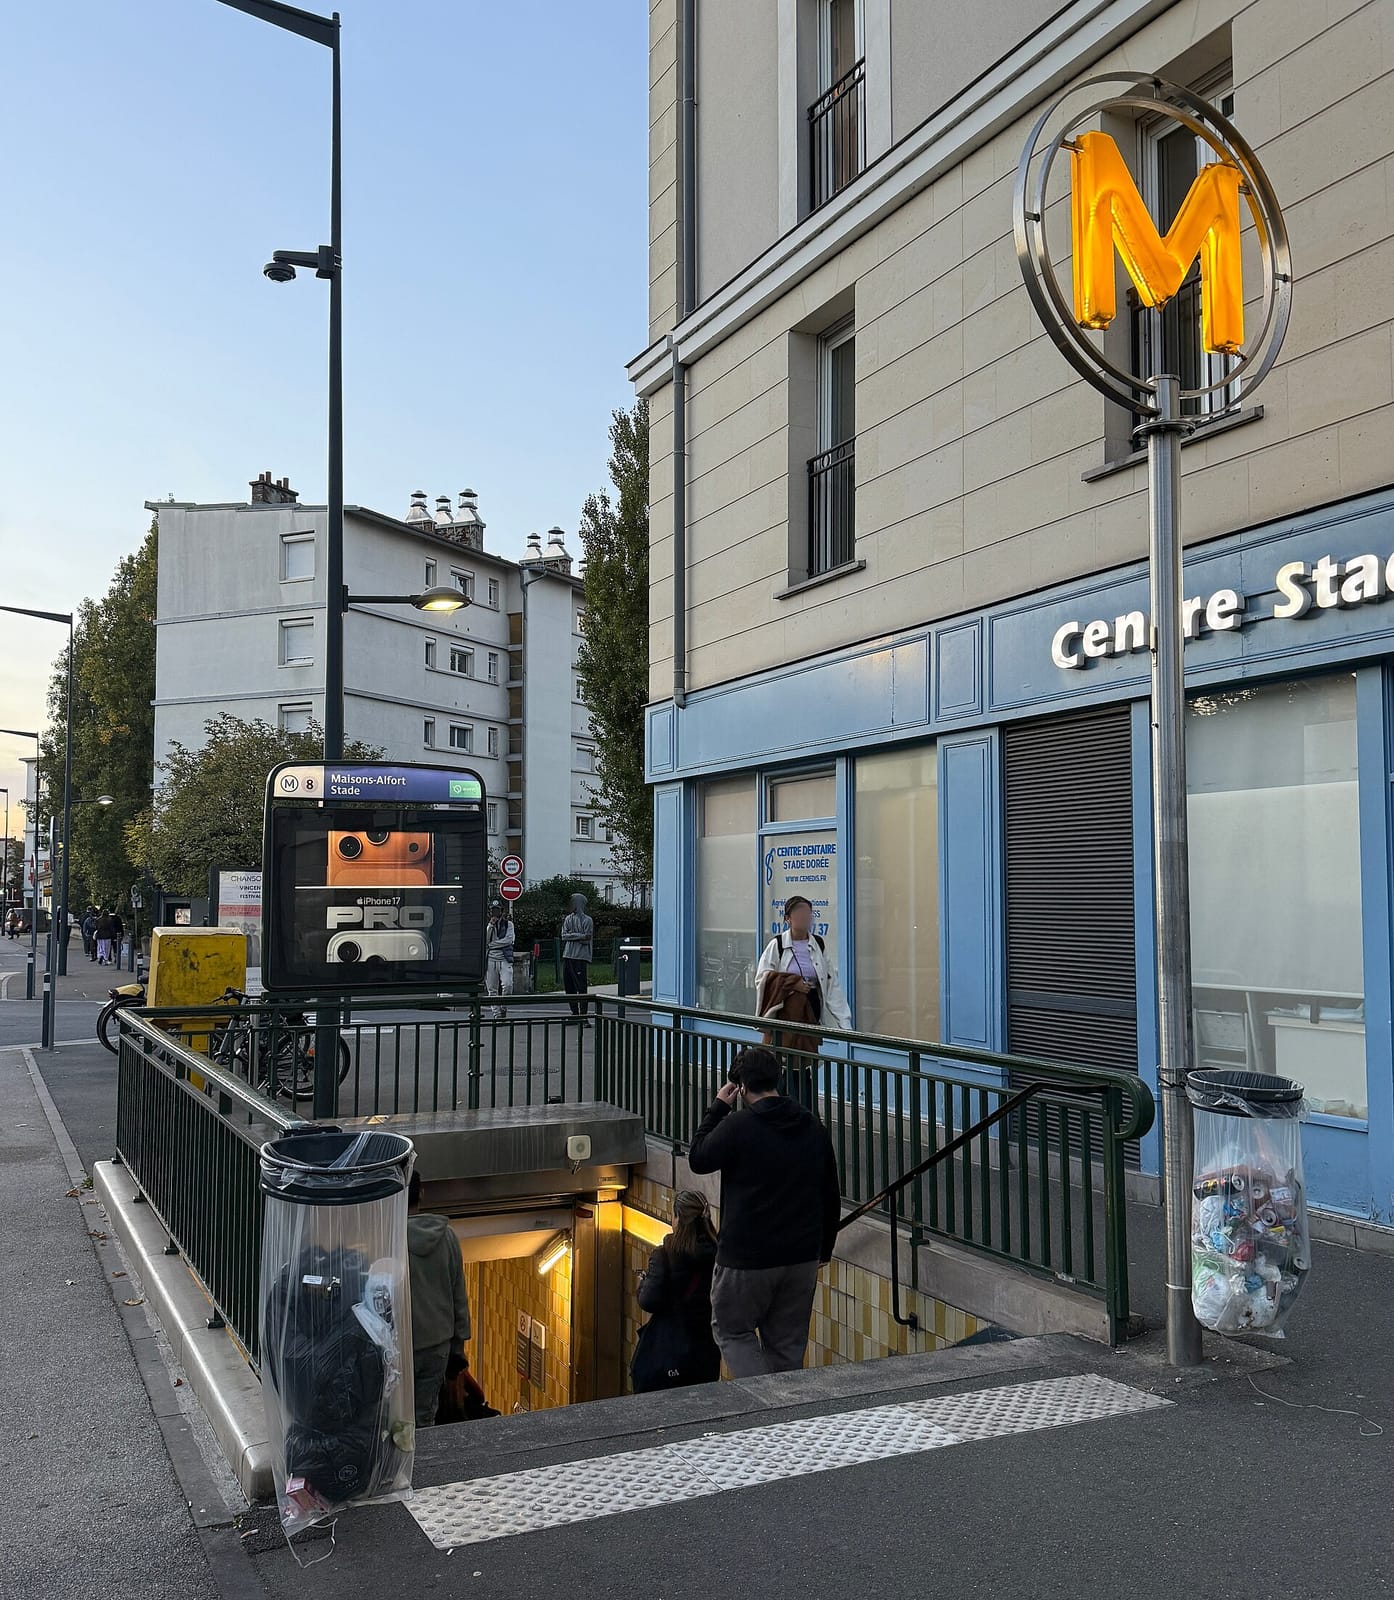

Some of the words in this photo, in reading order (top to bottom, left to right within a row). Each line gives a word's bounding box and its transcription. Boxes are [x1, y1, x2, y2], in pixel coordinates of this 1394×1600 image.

[1071, 130, 1245, 355] M
[1051, 588, 1244, 669] Cenre
[305, 779, 314, 790] 8
[331, 773, 407, 786] Maisons-Alfort
[331, 785, 360, 796] Stade
[777, 846, 802, 857] CENTRE
[803, 844, 837, 855] DENTAIRE
[783, 859, 805, 870] STADE
[806, 856, 829, 869] DORÉE
[363, 897, 391, 905] iPhone
[392, 897, 401, 905] 17
[326, 906, 434, 929] PRO
[771, 922, 781, 934] 01
[818, 923, 830, 936] 37
